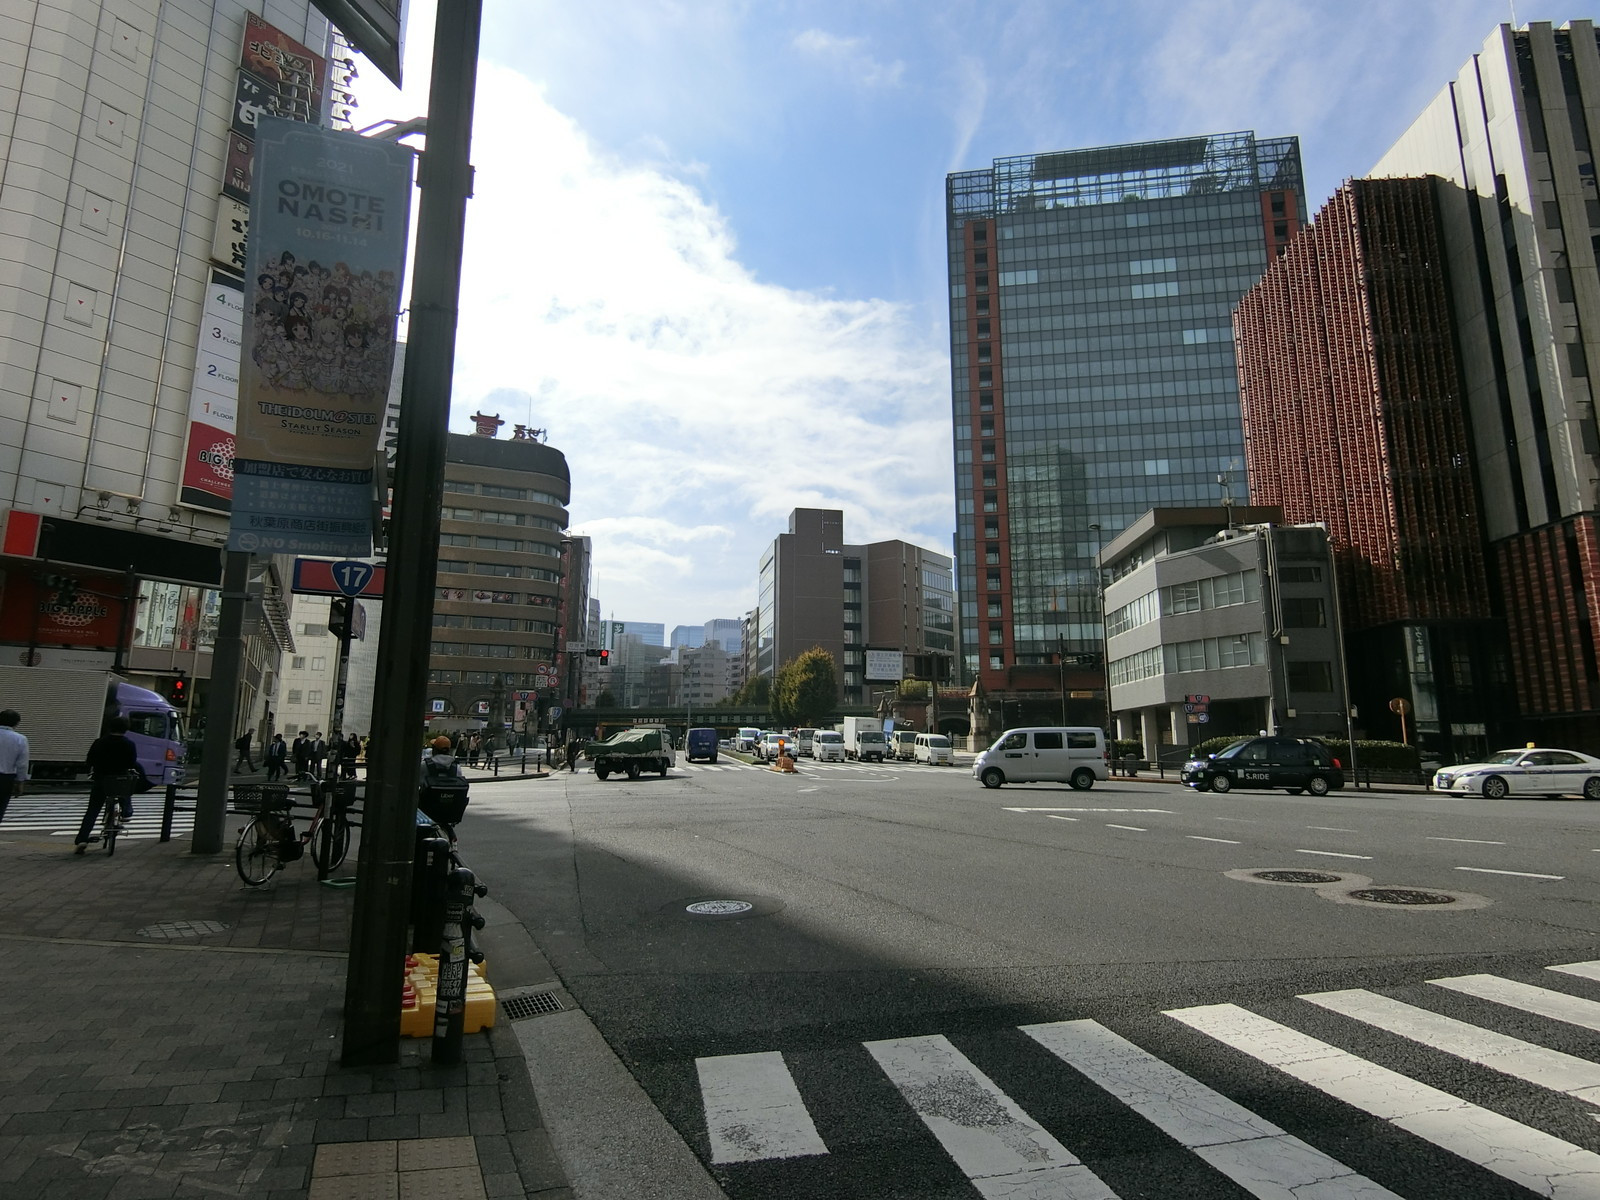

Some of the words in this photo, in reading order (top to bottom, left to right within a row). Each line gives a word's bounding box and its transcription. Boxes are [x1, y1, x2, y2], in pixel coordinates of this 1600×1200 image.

[242, 77, 260, 95] 7F
[316, 157, 353, 174] 2021
[278, 180, 385, 214] OMOTE
[216, 293, 226, 305] 4
[212, 327, 222, 339] 3
[207, 364, 217, 377] 2
[218, 373, 238, 384] FLOOR
[203, 402, 211, 414] 1
[212, 410, 234, 421] FLOOR
[198, 450, 224, 466] BIG
[200, 477, 231, 488] CHALLENGE
[261, 537, 285, 549] NO
[288, 539, 350, 554] Smoking
[341, 566, 367, 588] 17
[68, 605, 108, 617] APPLE
